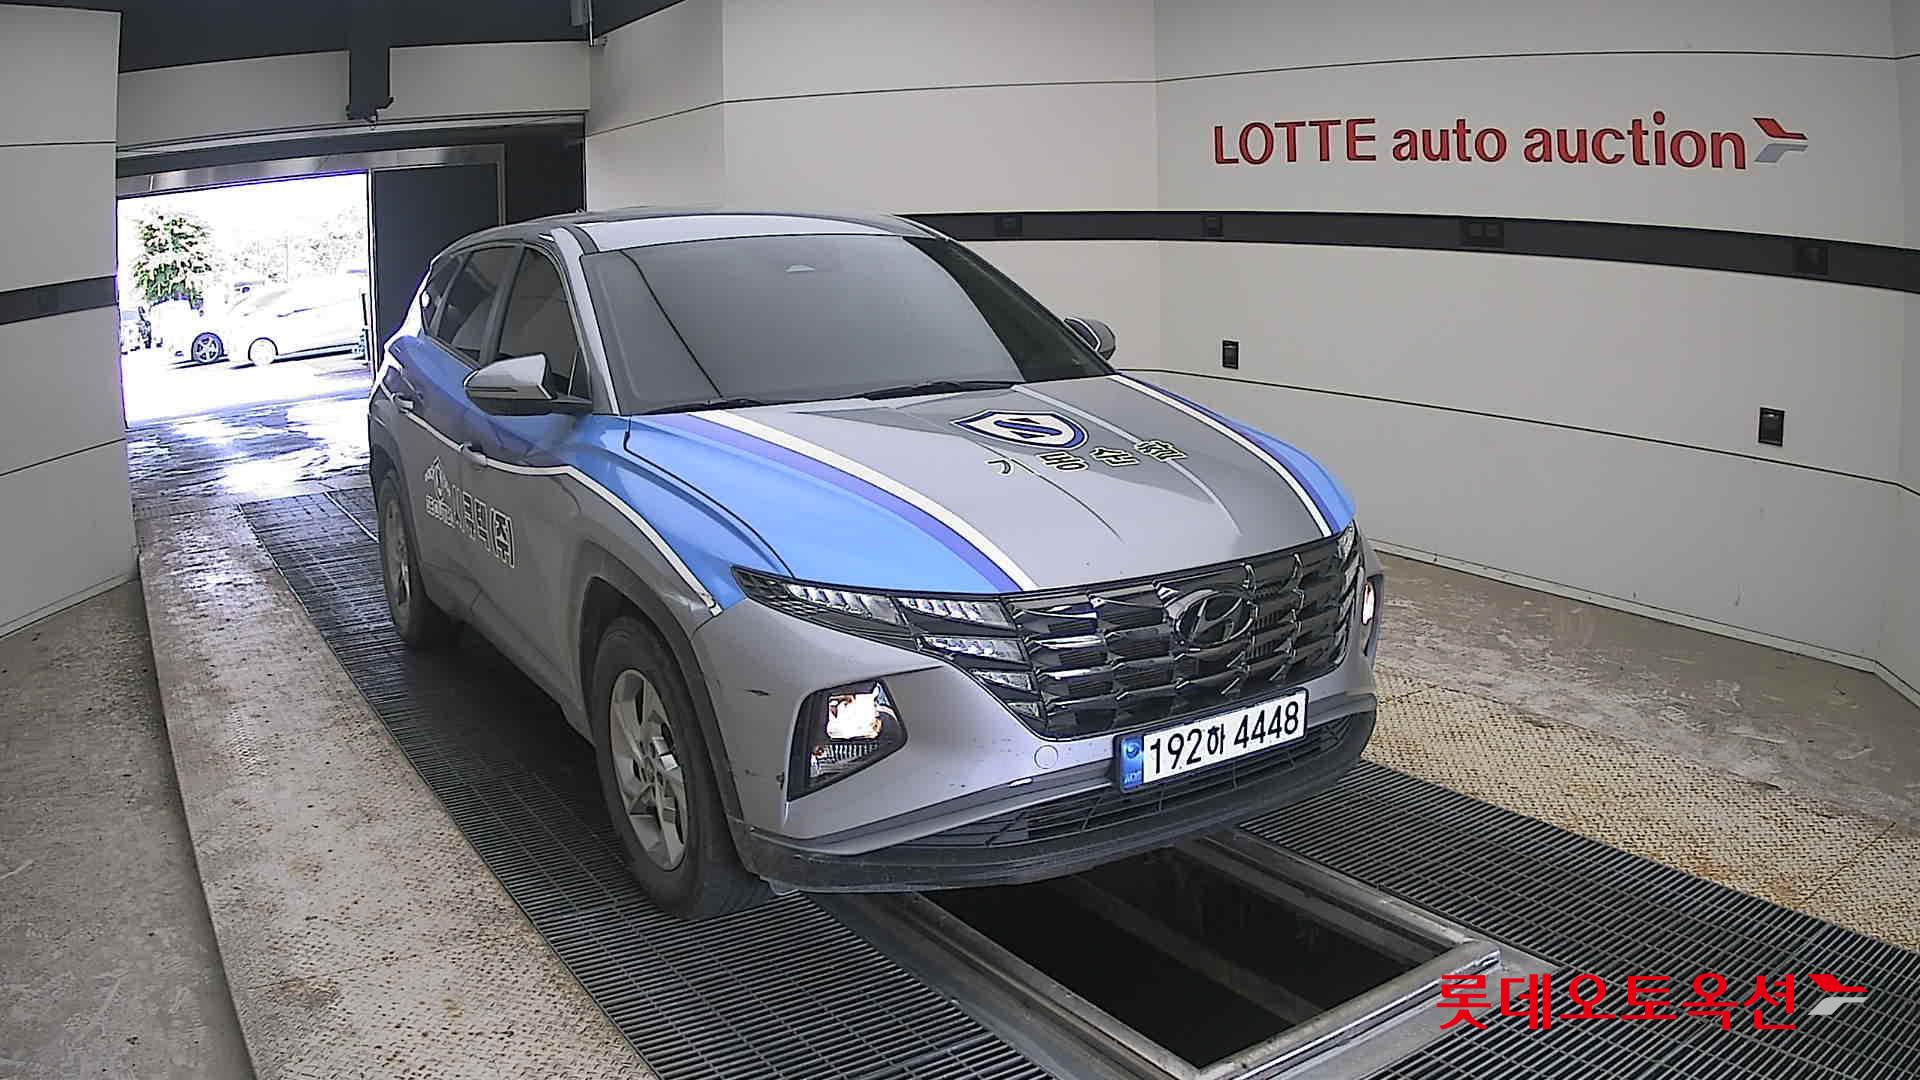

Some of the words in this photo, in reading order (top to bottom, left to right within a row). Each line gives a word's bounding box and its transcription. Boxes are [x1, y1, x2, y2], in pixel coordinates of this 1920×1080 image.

[1214, 118, 1377, 165] LOTTE
[1392, 118, 1508, 163] auto
[1523, 111, 1747, 169] auction
[985, 440, 1188, 476] 기동순찰
[1149, 723, 1227, 775] 192하
[1233, 701, 1300, 749] 4448
